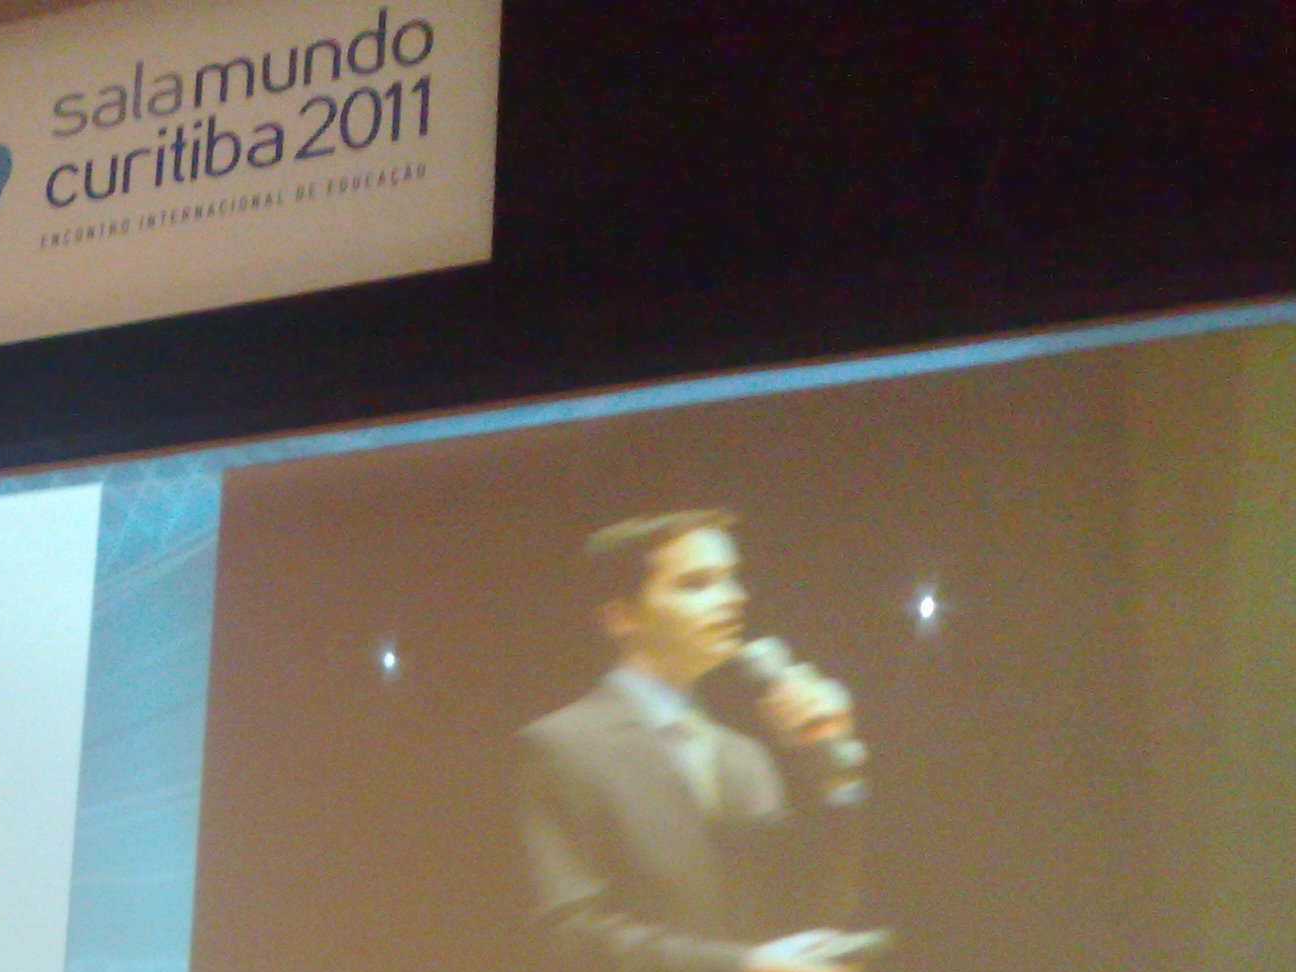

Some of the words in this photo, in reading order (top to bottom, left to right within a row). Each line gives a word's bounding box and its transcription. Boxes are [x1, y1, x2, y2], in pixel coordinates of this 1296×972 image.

[39, 216, 132, 249] ENCONTRO
[137, 188, 285, 230] INTERNACIONAL
[294, 182, 317, 202] DE
